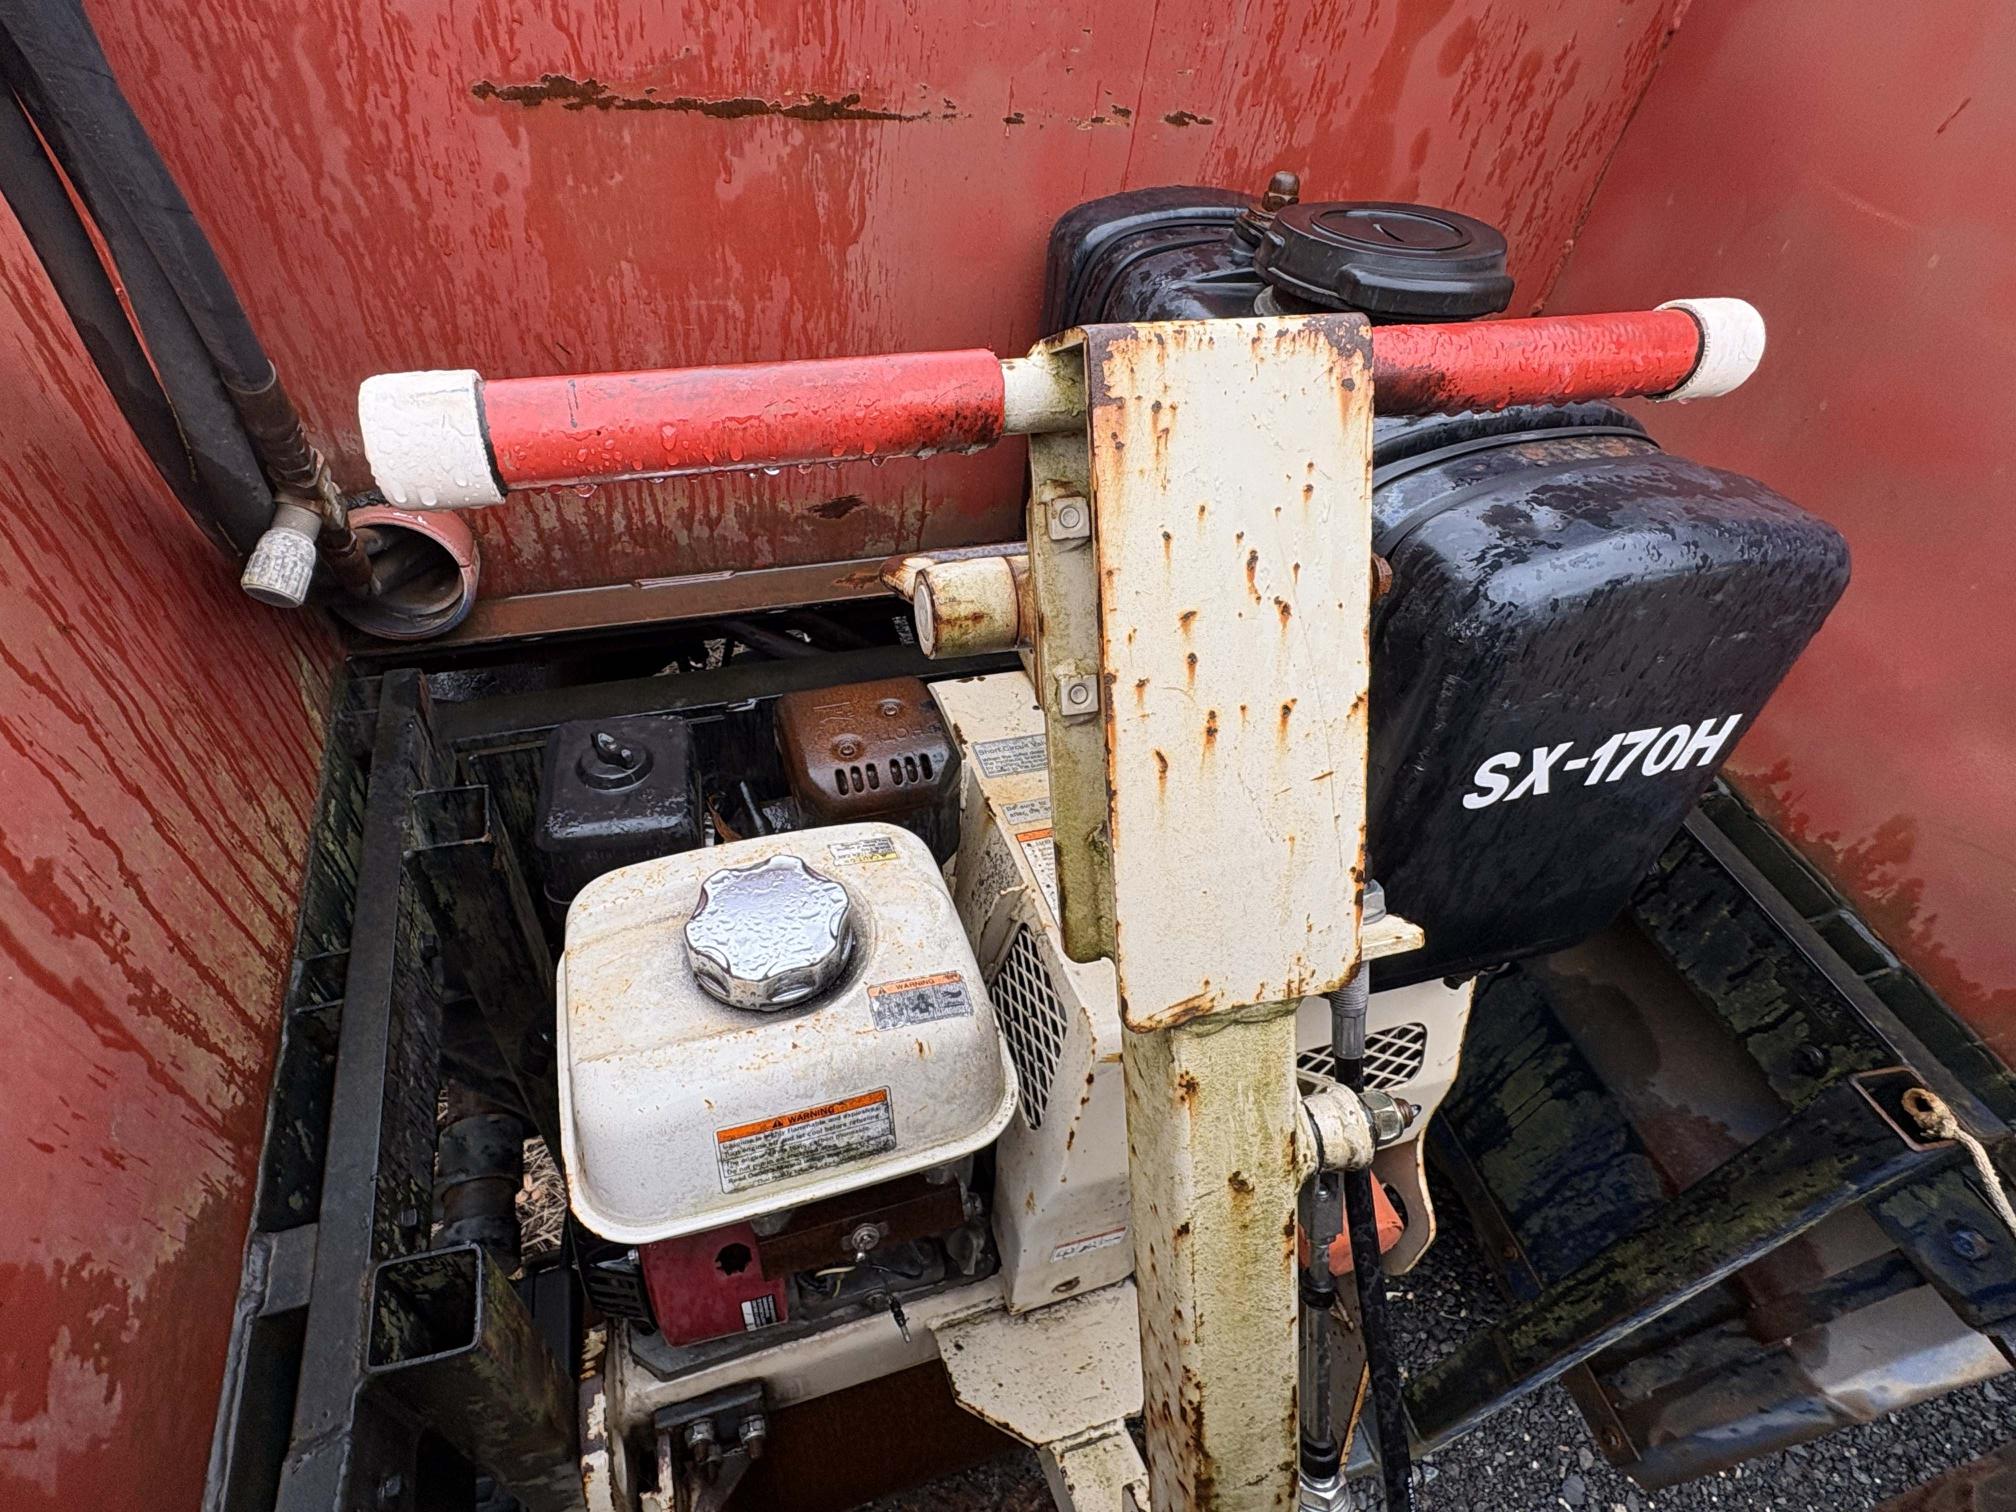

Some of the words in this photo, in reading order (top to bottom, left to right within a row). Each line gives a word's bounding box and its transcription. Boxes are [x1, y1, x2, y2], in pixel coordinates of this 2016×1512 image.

[977, 746, 1001, 755] Short
[1002, 741, 1028, 751] Circuit
[1463, 713, 1743, 809] SX-170H
[895, 978, 935, 990] WARNING
[786, 1118, 825, 1133] flammable
[827, 1113, 840, 1122] and
[787, 1105, 834, 1124] WARNING
[807, 1127, 822, 1136] cool
[824, 1120, 846, 1131] before
